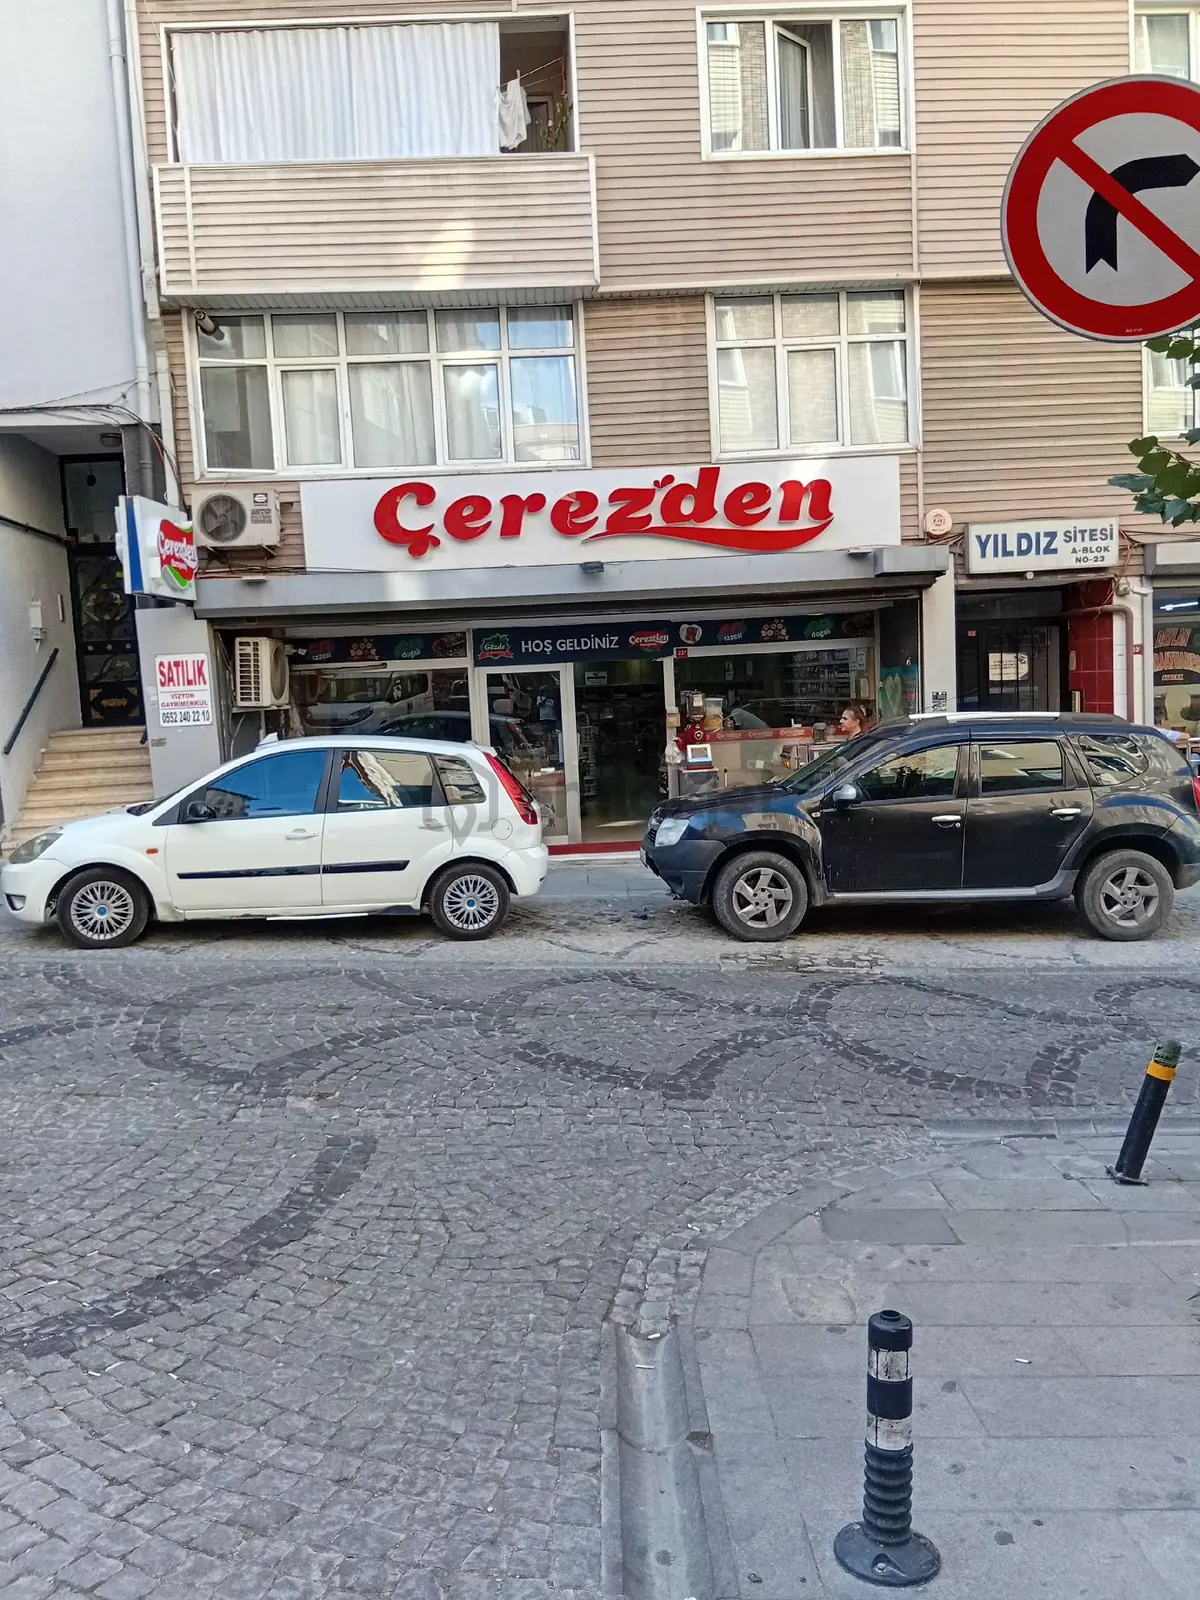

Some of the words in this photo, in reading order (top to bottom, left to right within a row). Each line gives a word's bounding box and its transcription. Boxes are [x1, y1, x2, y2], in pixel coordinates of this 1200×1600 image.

[975, 531, 1058, 559] YILDIZ
[1063, 524, 1114, 543] SİTESİ
[1071, 545, 1110, 554] A-BLOK
[1075, 555, 1105, 564] NO-23
[521, 639, 552, 655] HOŞ
[556, 633, 619, 651] GELDİNİZ
[158, 660, 207, 687] SATILIK
[170, 692, 195, 700] VİZYON
[160, 700, 208, 708] GAYRİMENKUL
[162, 712, 177, 723] 0552
[179, 711, 190, 722] 240
[192, 710, 200, 721] 22
[202, 710, 210, 721] 10
